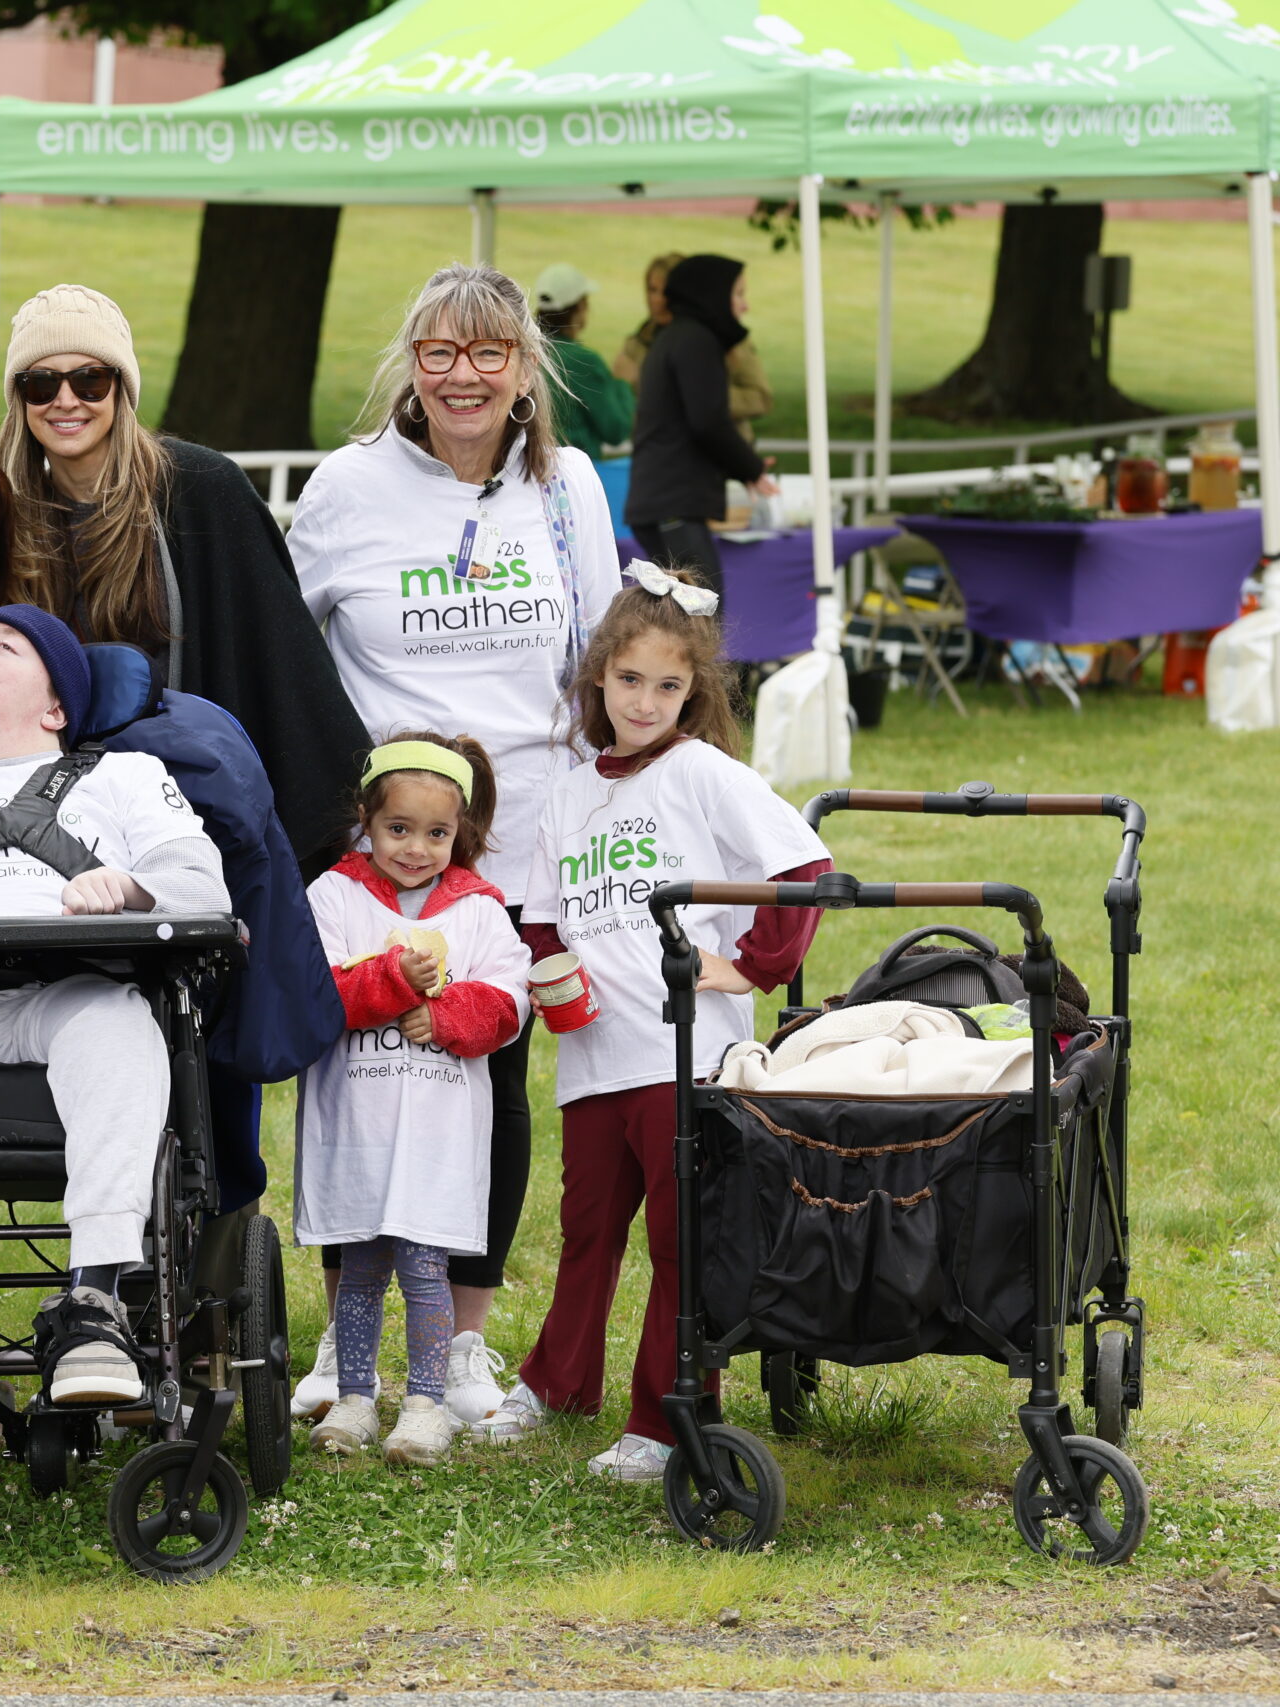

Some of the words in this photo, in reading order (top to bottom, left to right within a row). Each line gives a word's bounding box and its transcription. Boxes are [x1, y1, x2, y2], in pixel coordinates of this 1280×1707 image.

[36, 111, 235, 164] enriching
[243, 110, 351, 153] lives.
[362, 106, 548, 162] growing
[560, 97, 748, 146] abilities.
[844, 96, 972, 147] enriching
[1040, 96, 1141, 147] growing
[1145, 94, 1238, 137] abilities.
[536, 571, 555, 587] for
[402, 596, 565, 634] matheny
[404, 633, 558, 656] wheel.walk.run.fun.
[60, 811, 83, 826] for
[559, 833, 658, 889] miles
[662, 851, 686, 868] for
